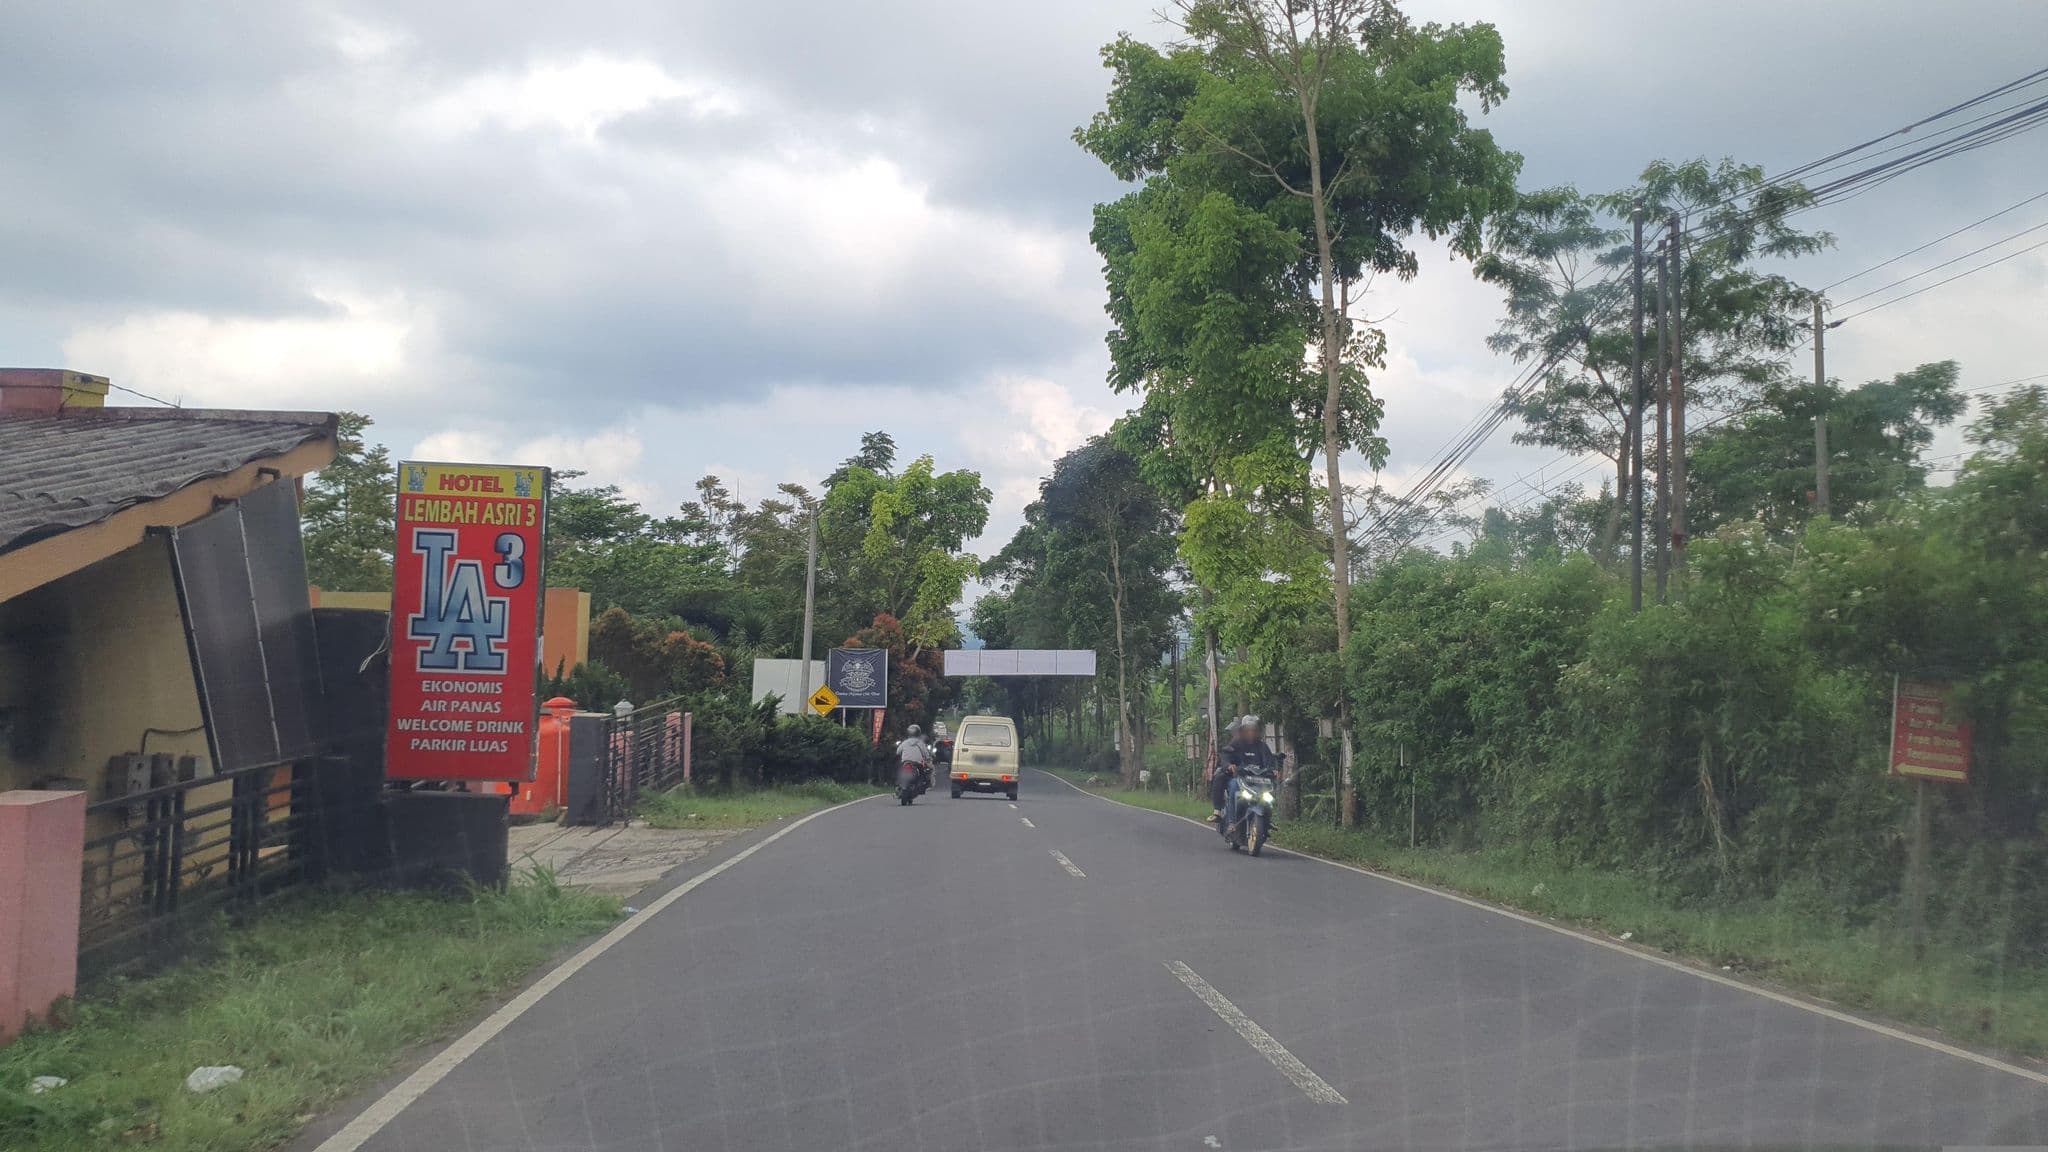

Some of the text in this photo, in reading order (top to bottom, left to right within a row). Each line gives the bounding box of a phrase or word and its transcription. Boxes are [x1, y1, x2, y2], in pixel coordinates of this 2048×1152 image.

[439, 474, 503, 492] HOTEL
[404, 499, 535, 526] LEMBAH ASRI 3
[421, 680, 503, 694] EKONOMIS
[420, 699, 501, 713] AIR PANAS
[397, 718, 524, 734] WELCOME DRINK
[410, 738, 508, 752] PARKIR LUAS
